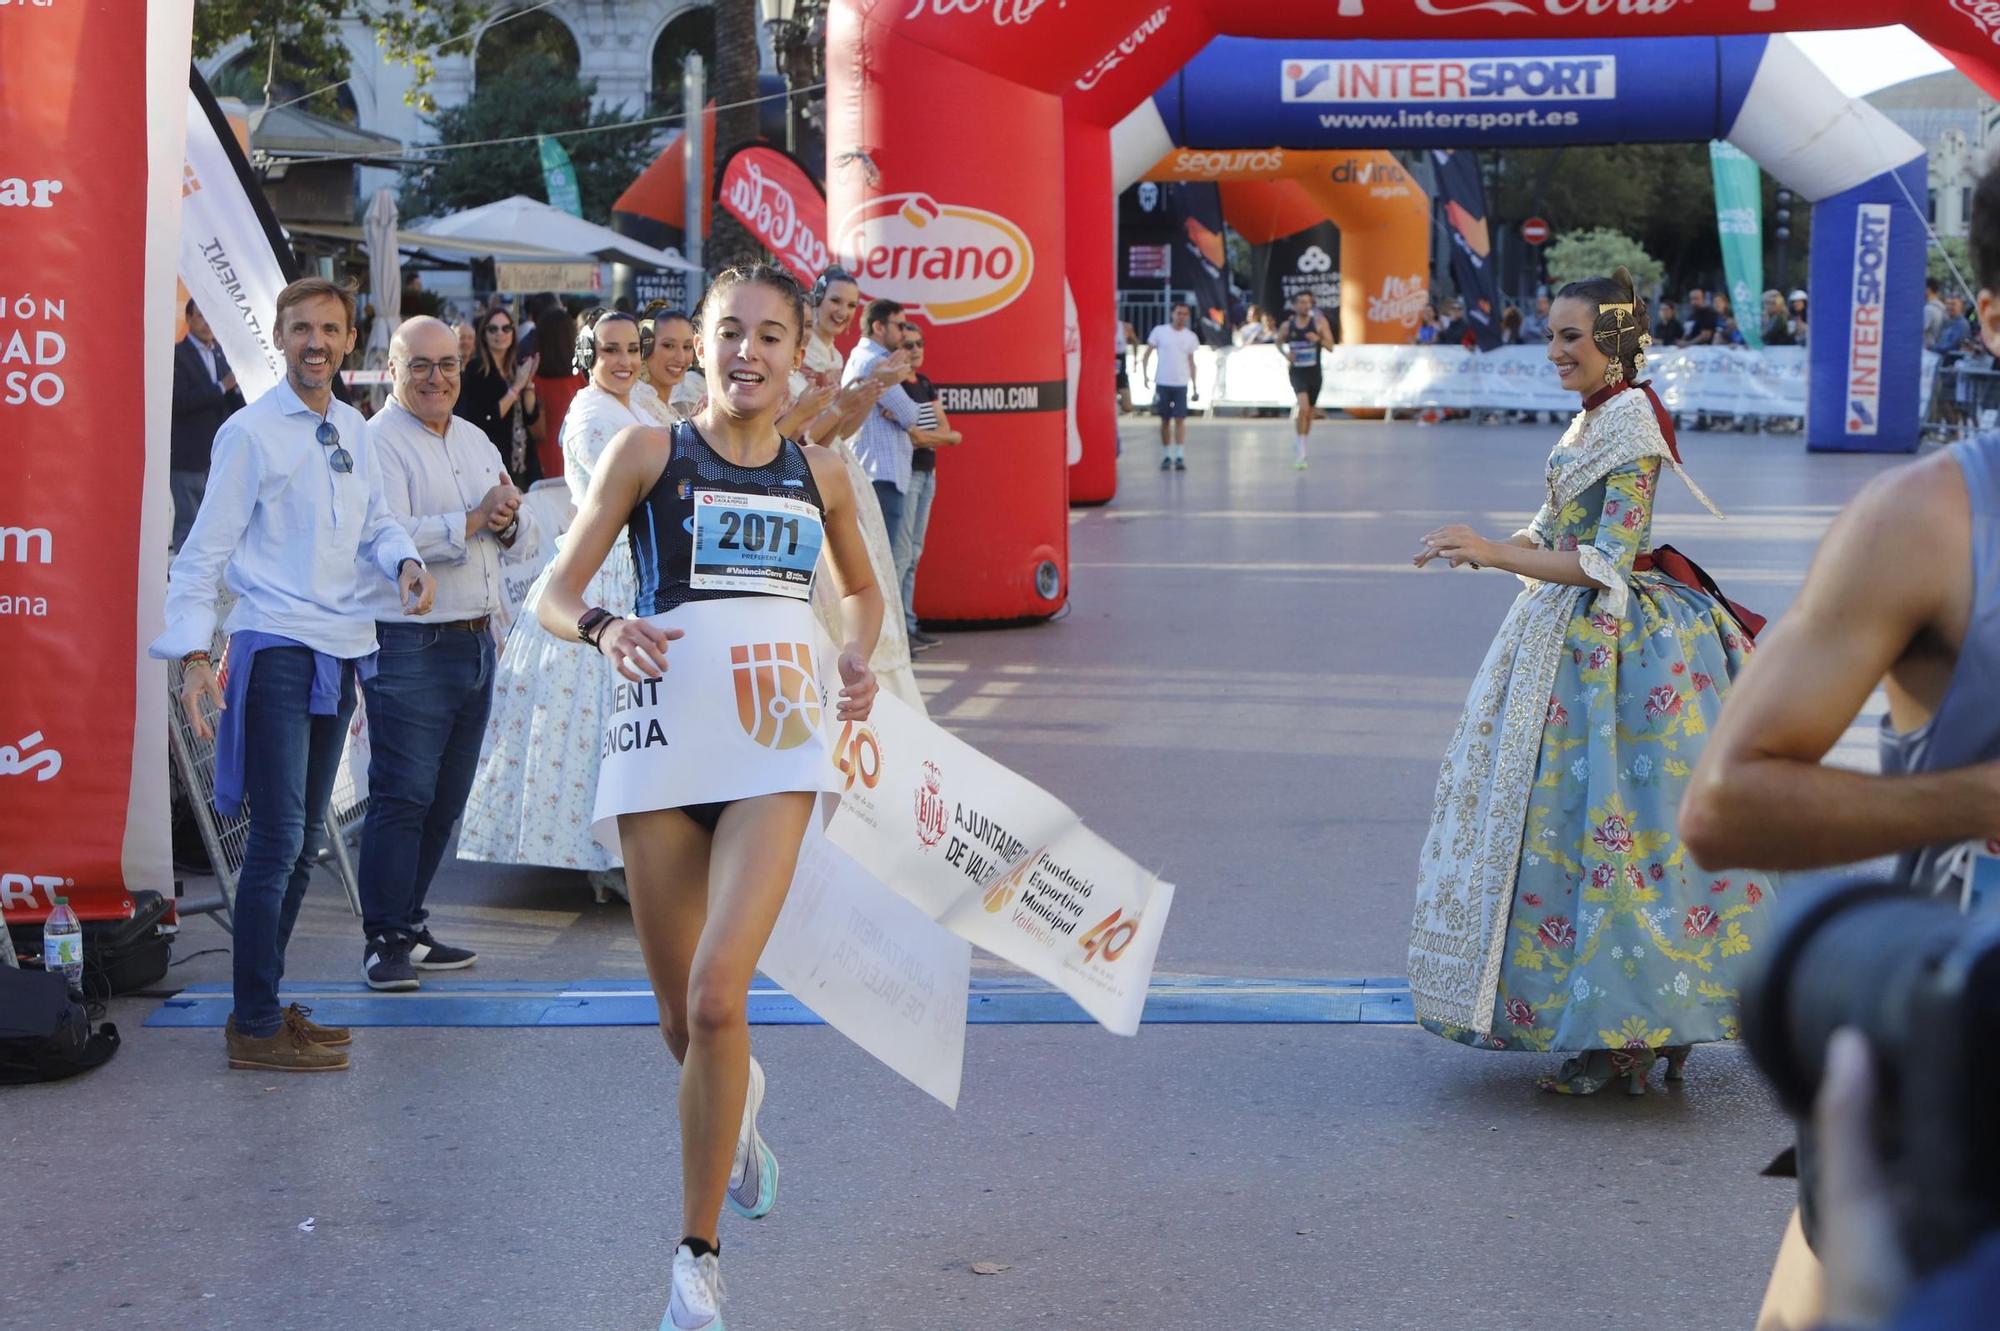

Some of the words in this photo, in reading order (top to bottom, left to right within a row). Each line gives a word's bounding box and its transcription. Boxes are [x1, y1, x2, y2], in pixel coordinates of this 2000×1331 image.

[1338, 61, 1604, 98] INTERSPORT
[1319, 109, 1579, 131] www.intersport.es
[1173, 151, 1284, 176] seguros
[0, 178, 63, 208] ar
[846, 229, 1013, 281] Serrano
[636, 286, 686, 299] TRINID
[1851, 212, 1886, 396] INTERSPORT
[0, 329, 66, 365] AD
[5, 371, 65, 406] SO
[938, 387, 1038, 410] ERRANO.COM
[718, 511, 799, 556] 2071
[0, 595, 48, 616] ana
[613, 677, 663, 714] ENT
[945, 836, 969, 869] DE
[955, 802, 1029, 866] AJUNTAMEN
[1028, 871, 1085, 918] Esportiva
[1037, 853, 1094, 899] Fundació
[1011, 907, 1057, 947] València
[1020, 889, 1078, 935] Municipal
[1077, 907, 1138, 964] 40
